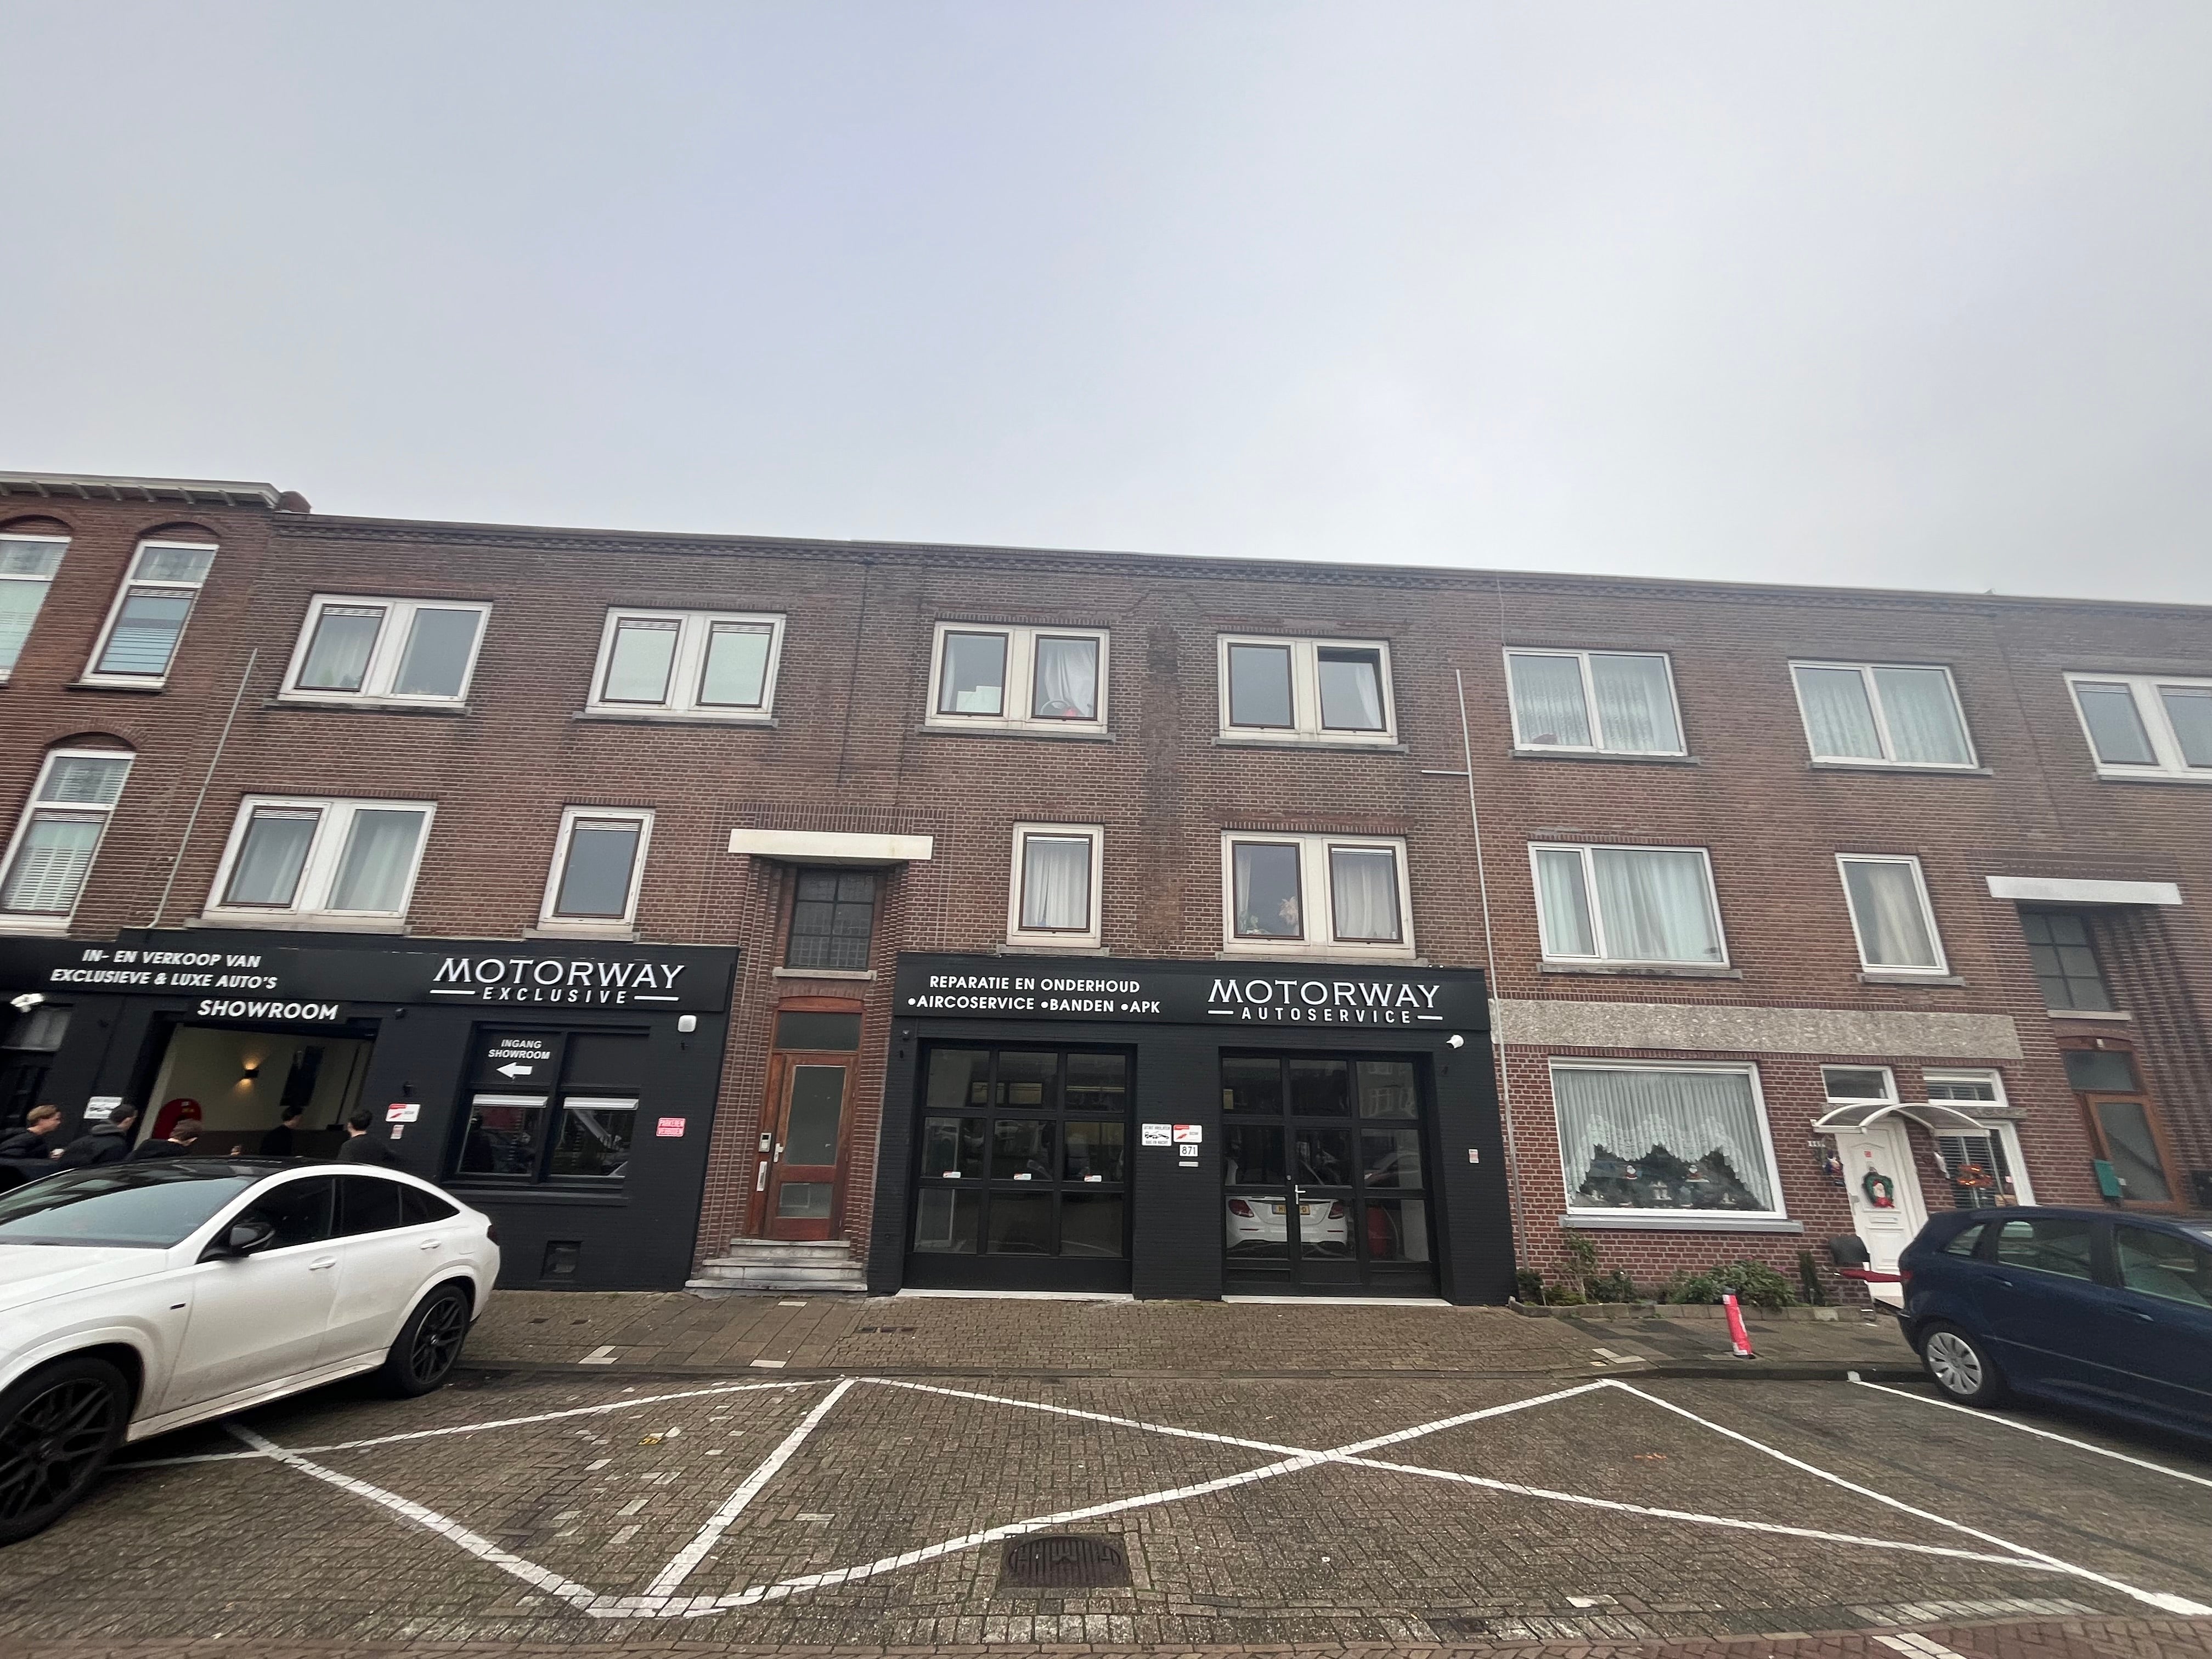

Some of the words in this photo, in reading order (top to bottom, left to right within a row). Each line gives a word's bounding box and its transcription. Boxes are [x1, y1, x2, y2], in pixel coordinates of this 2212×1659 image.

[82, 949, 110, 962] IN-
[113, 950, 139, 963] EN
[143, 951, 222, 966] VERKOOP
[226, 955, 262, 968] VAN
[49, 969, 153, 985] EXCLUSIEVE
[154, 972, 167, 985] &
[170, 973, 214, 987] LUXE
[215, 975, 278, 989] AUTO'S
[432, 957, 685, 989] MOTORWAY
[929, 975, 1009, 990] REPARATIE
[1015, 978, 1035, 990] EN
[1040, 978, 1140, 993] ONDERHOUD
[482, 986, 627, 1004] EXCLUSIVE
[1207, 979, 1440, 1008] MOTORWAY
[197, 1000, 339, 1020] SHOWROOM
[1242, 1007, 1410, 1024] AUTOSERVICE
[501, 1039, 542, 1049] INGANG
[488, 1049, 551, 1059] SHOWROOM
[1182, 1146, 1195, 1155] 871
